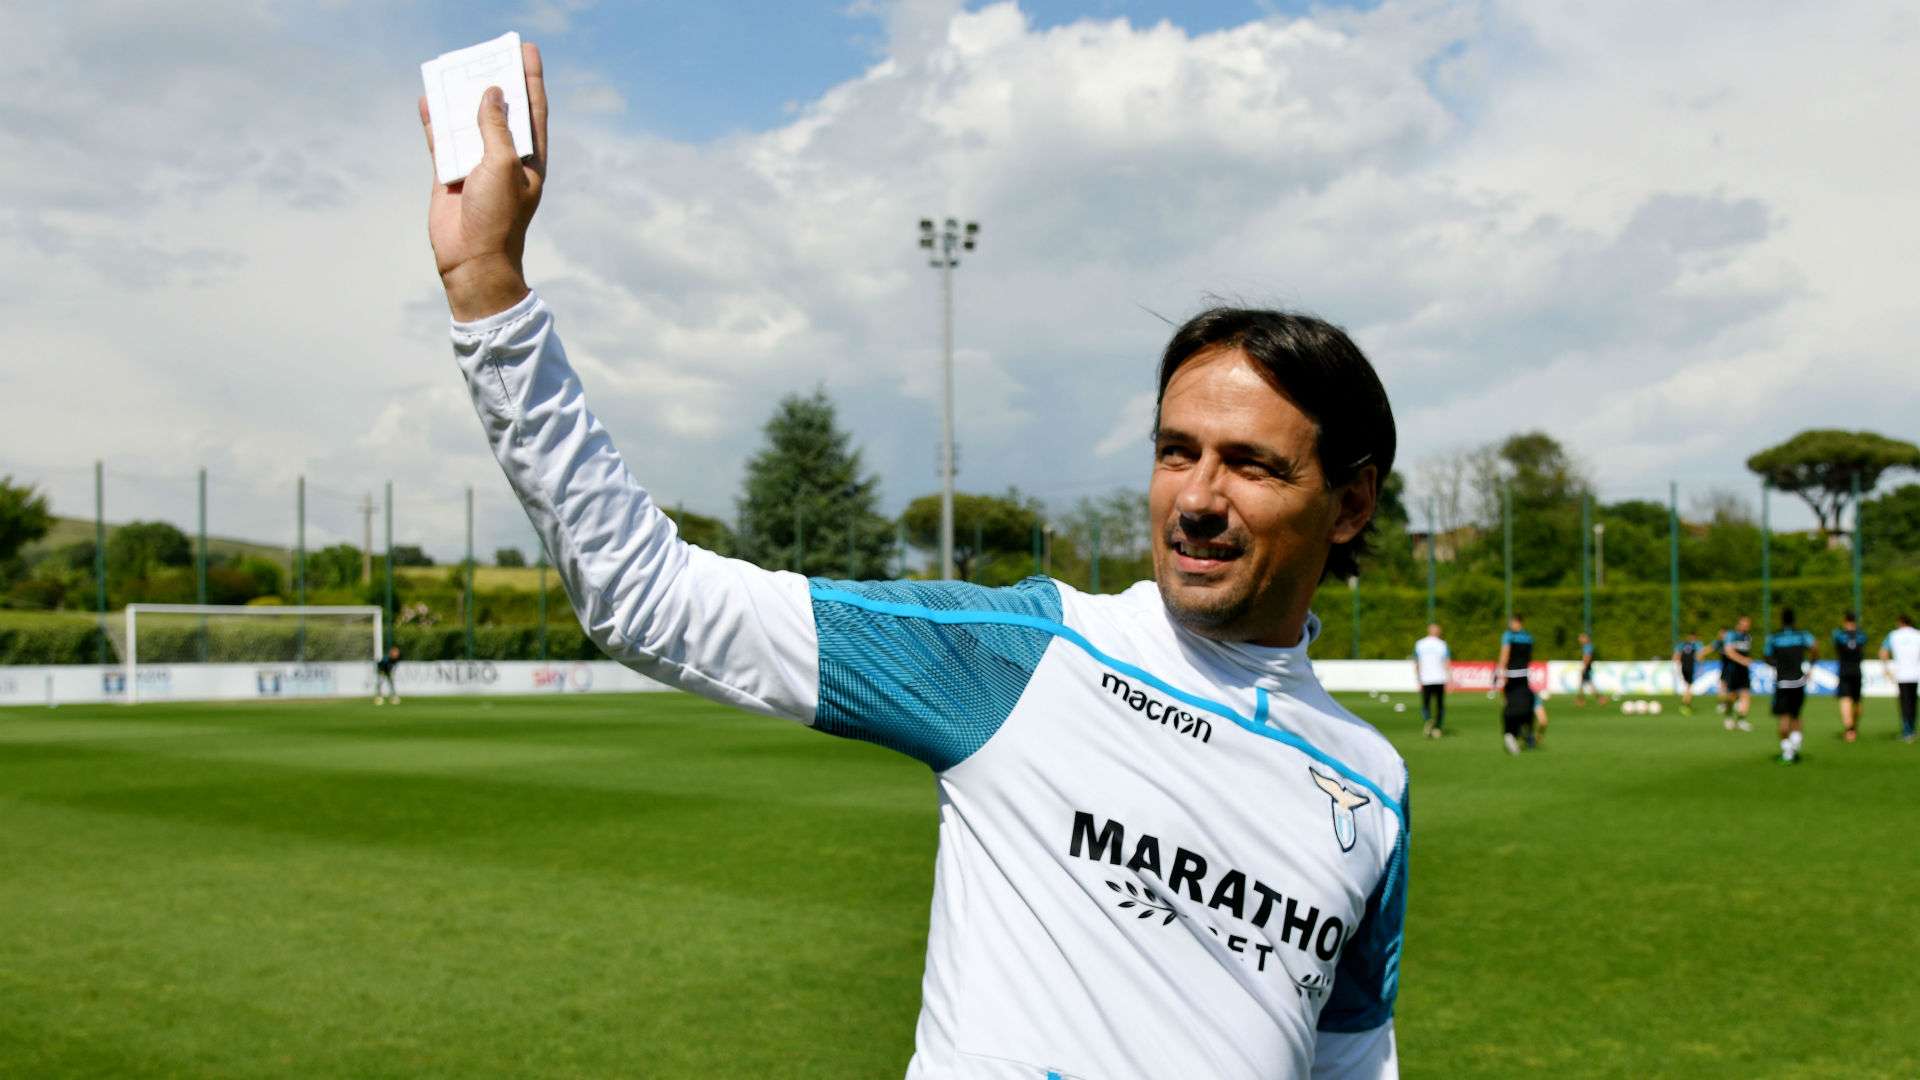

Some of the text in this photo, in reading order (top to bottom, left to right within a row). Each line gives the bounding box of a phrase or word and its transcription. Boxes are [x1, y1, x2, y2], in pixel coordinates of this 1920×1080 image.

[1101, 671, 1212, 744] macron
[1068, 810, 1351, 962] MARATHO
[1208, 926, 1274, 972] ET
